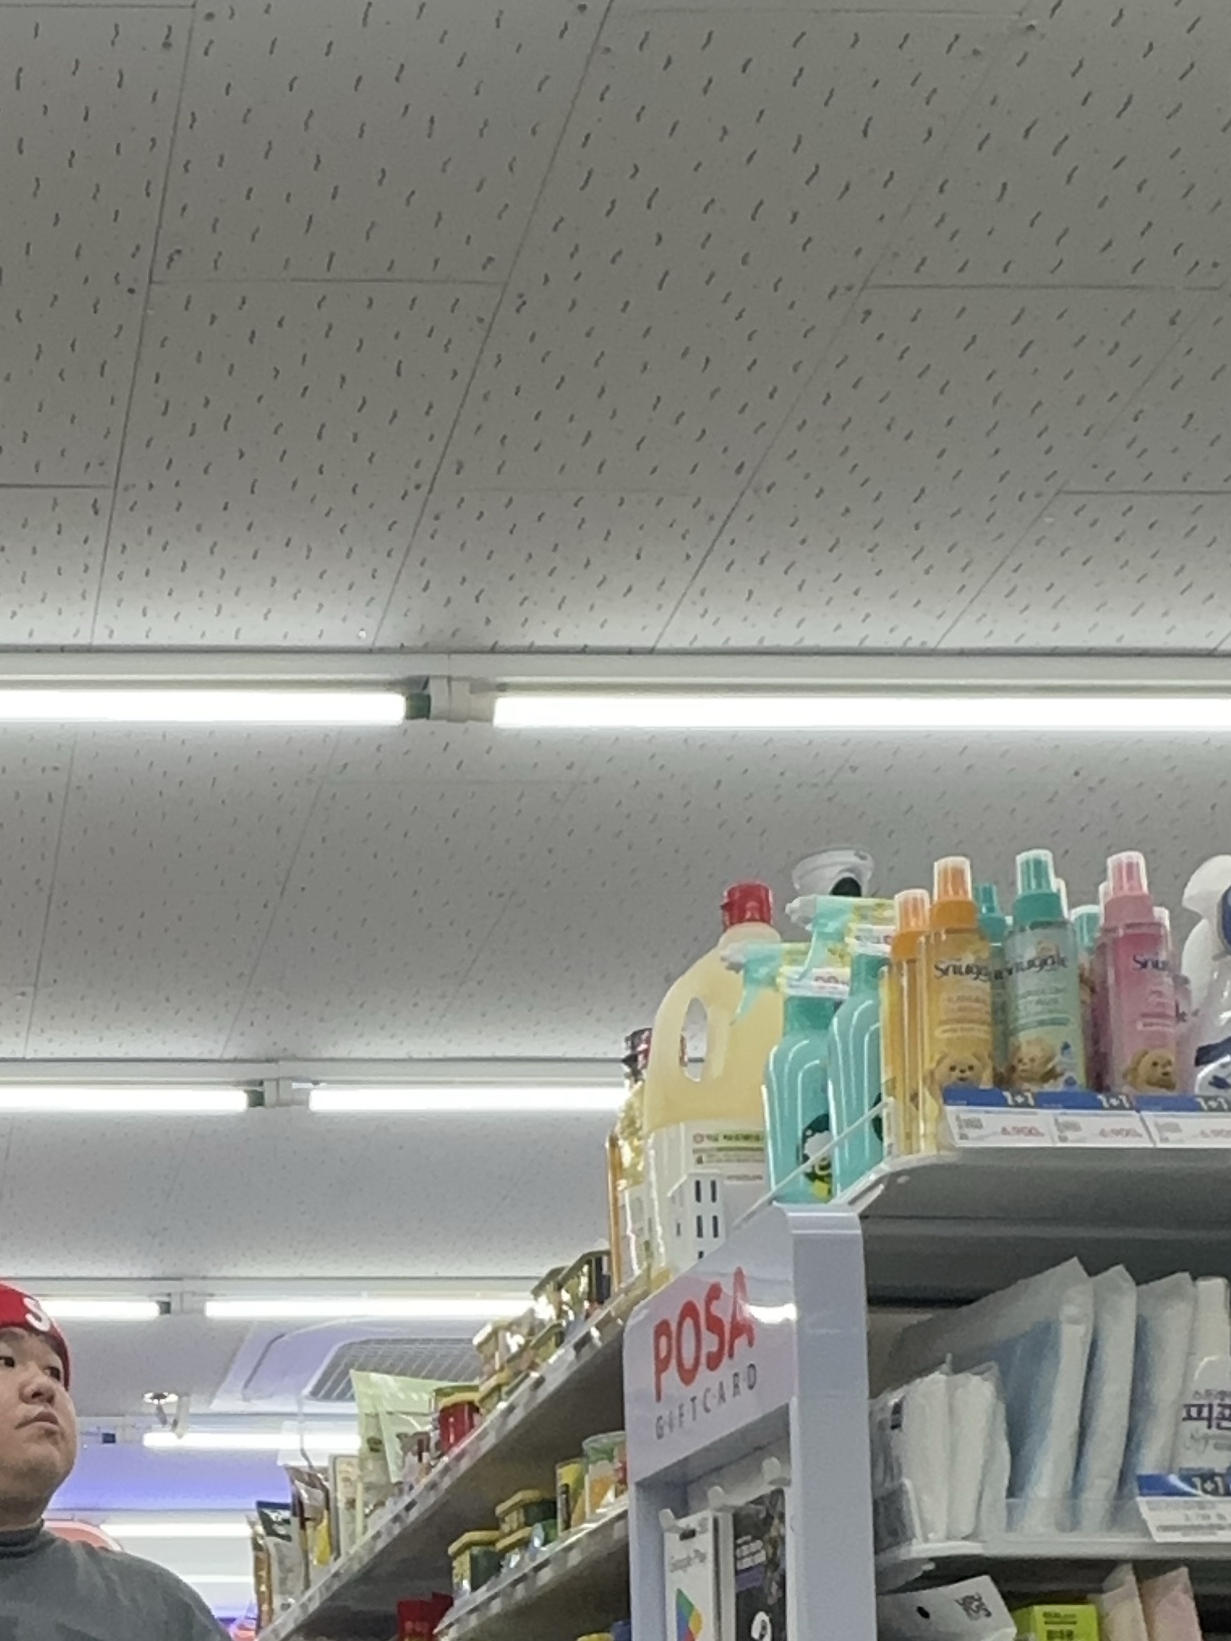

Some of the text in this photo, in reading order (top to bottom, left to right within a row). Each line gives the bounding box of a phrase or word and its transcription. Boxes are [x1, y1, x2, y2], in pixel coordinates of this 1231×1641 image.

[1002, 1090, 1035, 1107] 1+1
[1096, 1094, 1130, 1109] 1+1
[653, 1265, 756, 1403] POSA
